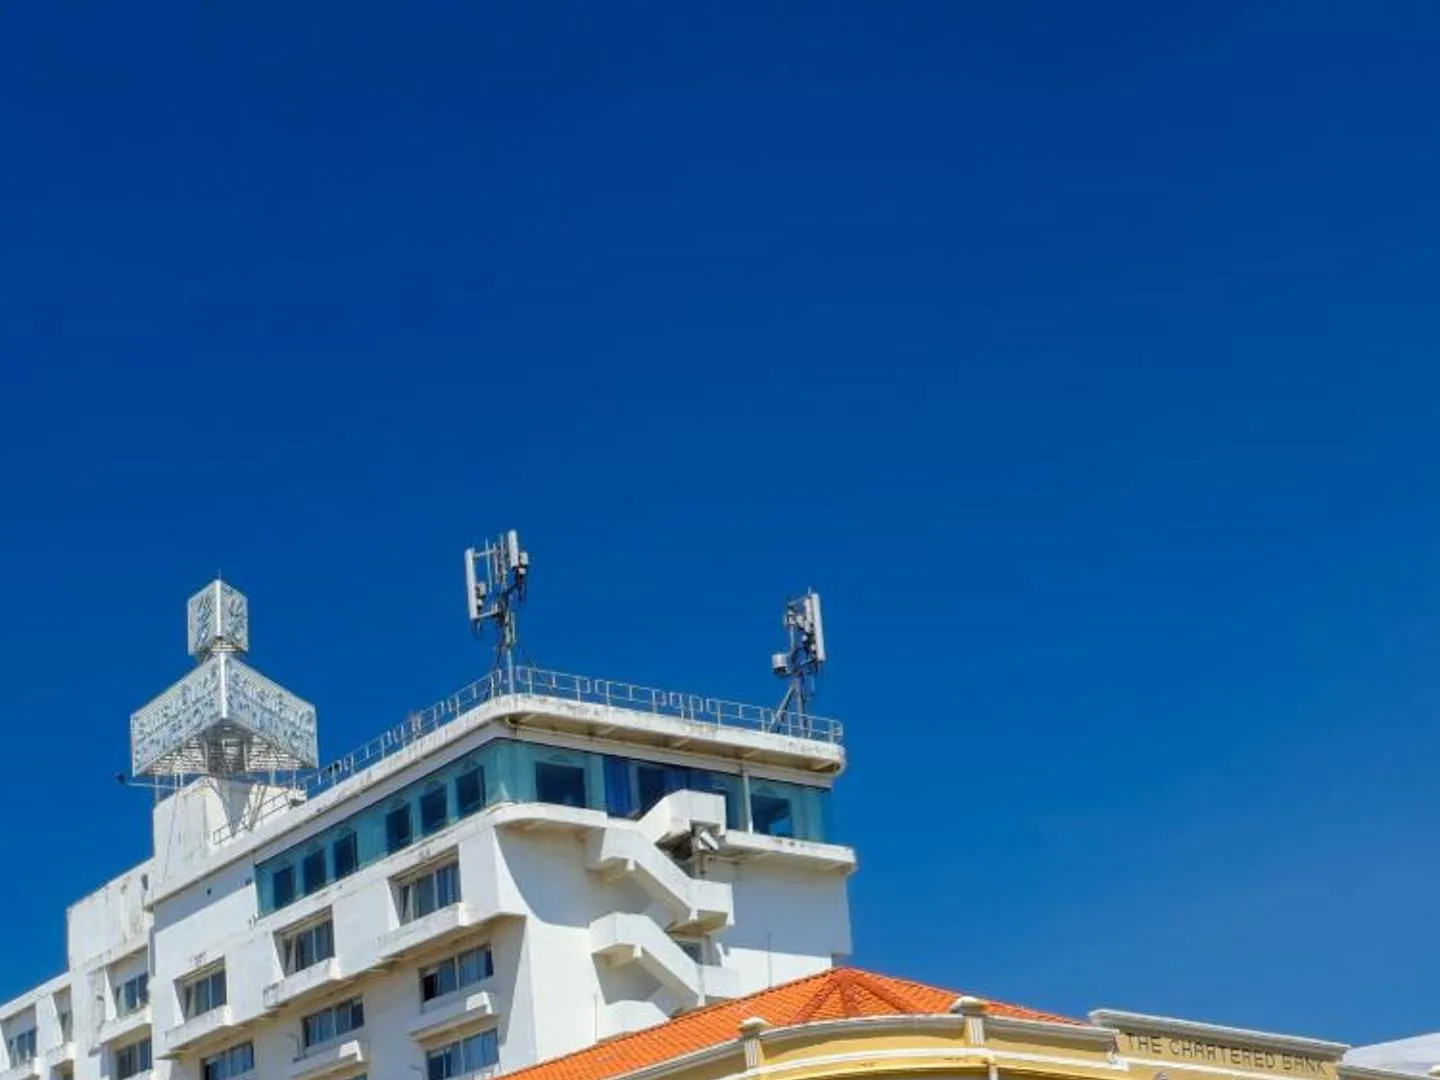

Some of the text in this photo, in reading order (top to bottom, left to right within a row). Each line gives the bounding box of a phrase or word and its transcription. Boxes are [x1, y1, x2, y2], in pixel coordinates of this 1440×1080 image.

[1125, 1032, 1329, 1075] THE CHARTERED BANK
